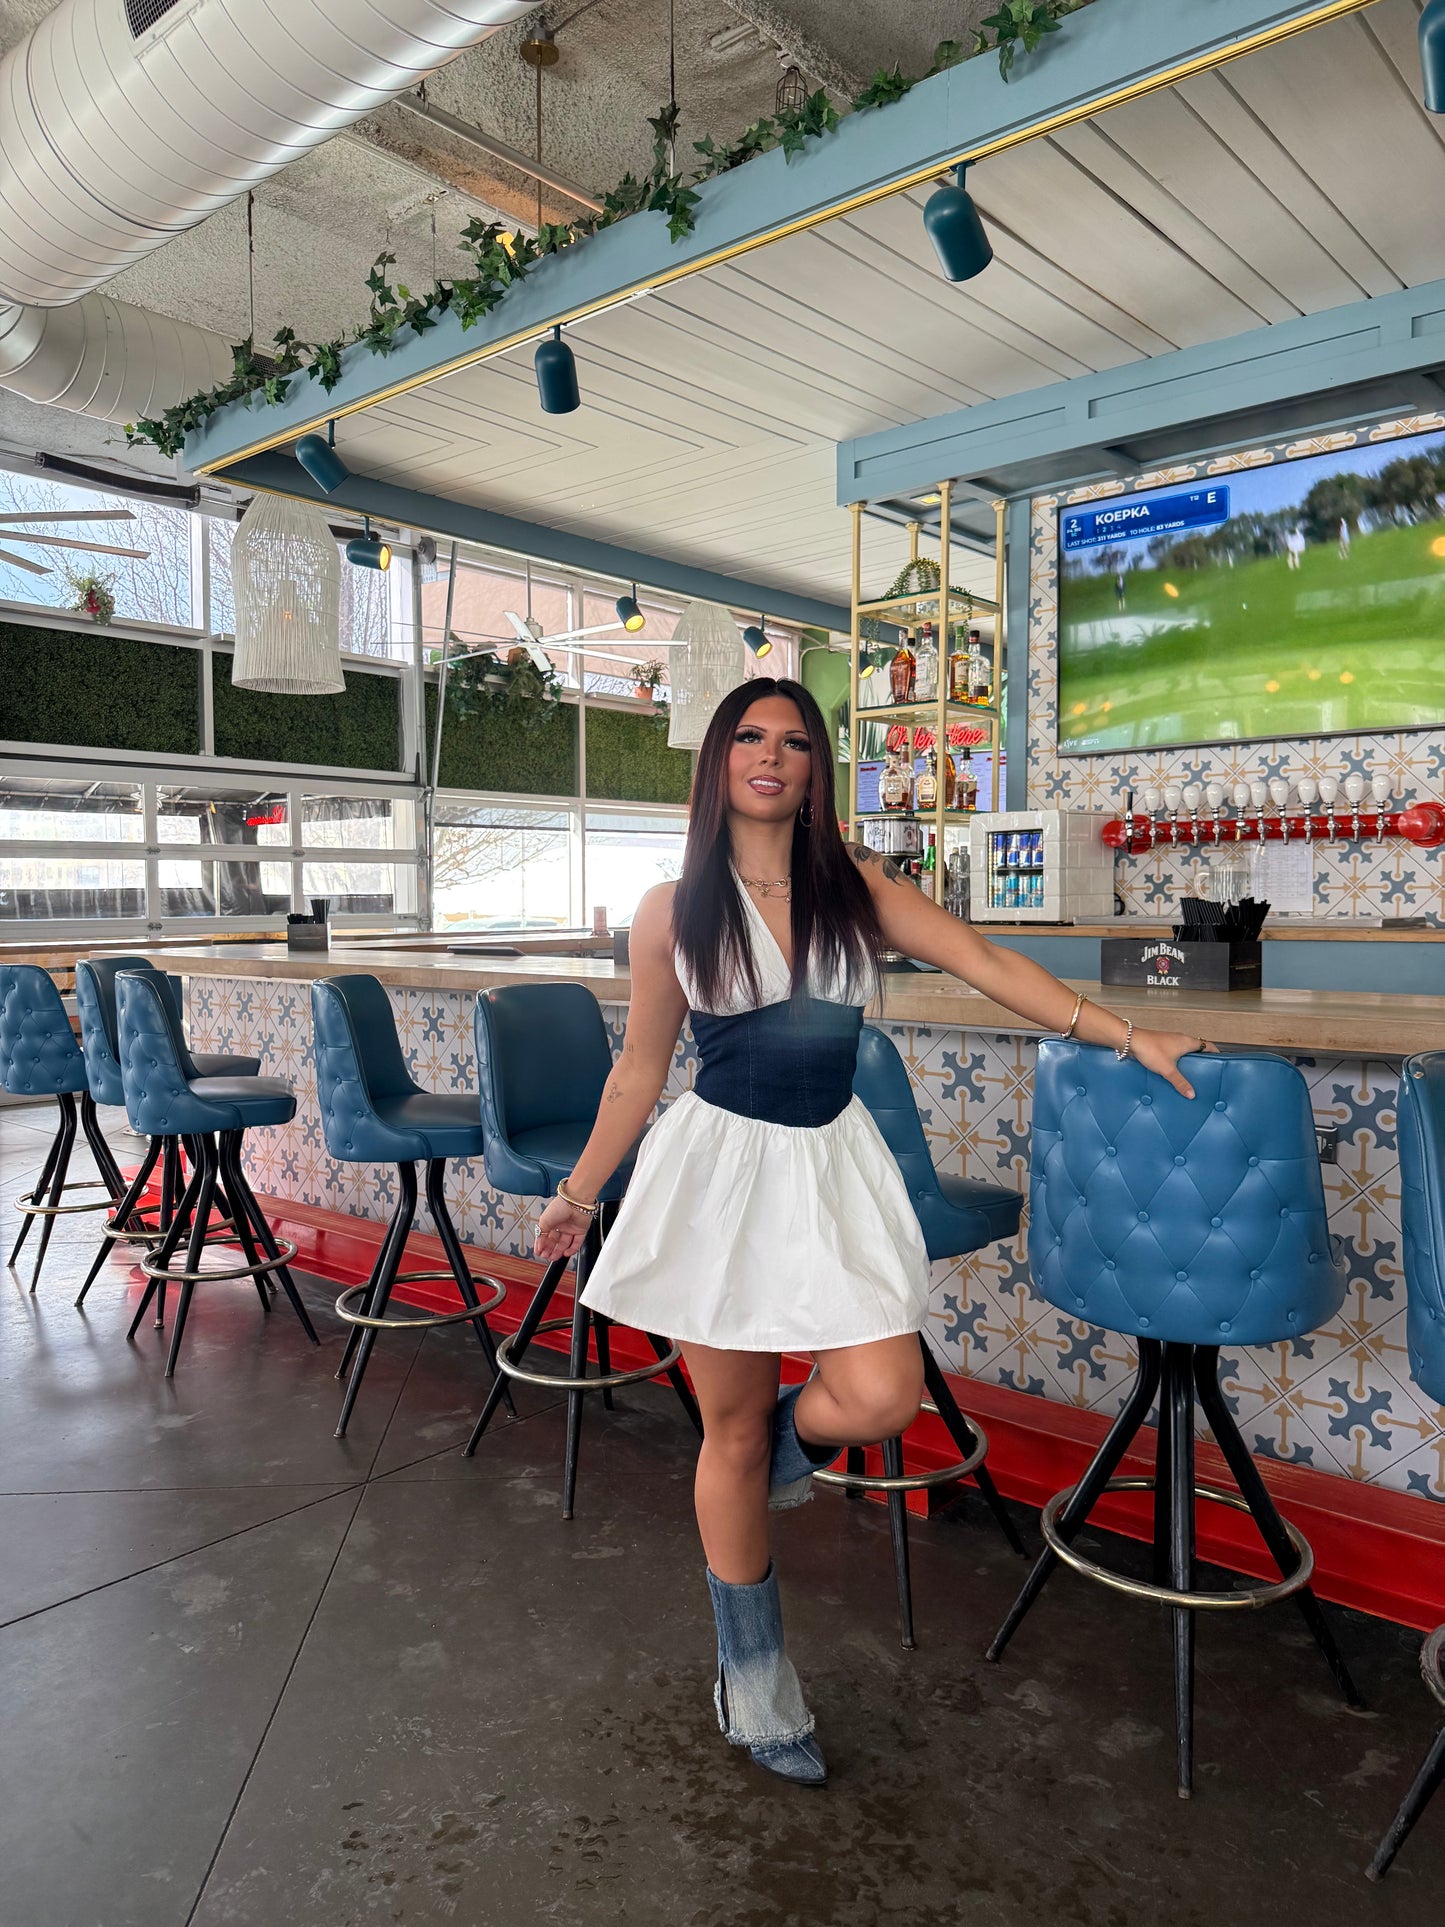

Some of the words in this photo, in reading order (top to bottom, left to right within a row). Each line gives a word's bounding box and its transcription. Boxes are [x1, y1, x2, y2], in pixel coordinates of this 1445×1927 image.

[1207, 491, 1217, 504] E
[1070, 519, 1078, 529] 2
[1095, 505, 1150, 526] KOEPKA
[1066, 540, 1080, 548] LAST
[1107, 531, 1126, 540] YARDS
[1164, 520, 1185, 530] YARDS
[1141, 945, 1159, 963] JIM
[1159, 942, 1185, 964] BEAM
[1146, 975, 1180, 987] BLACK
